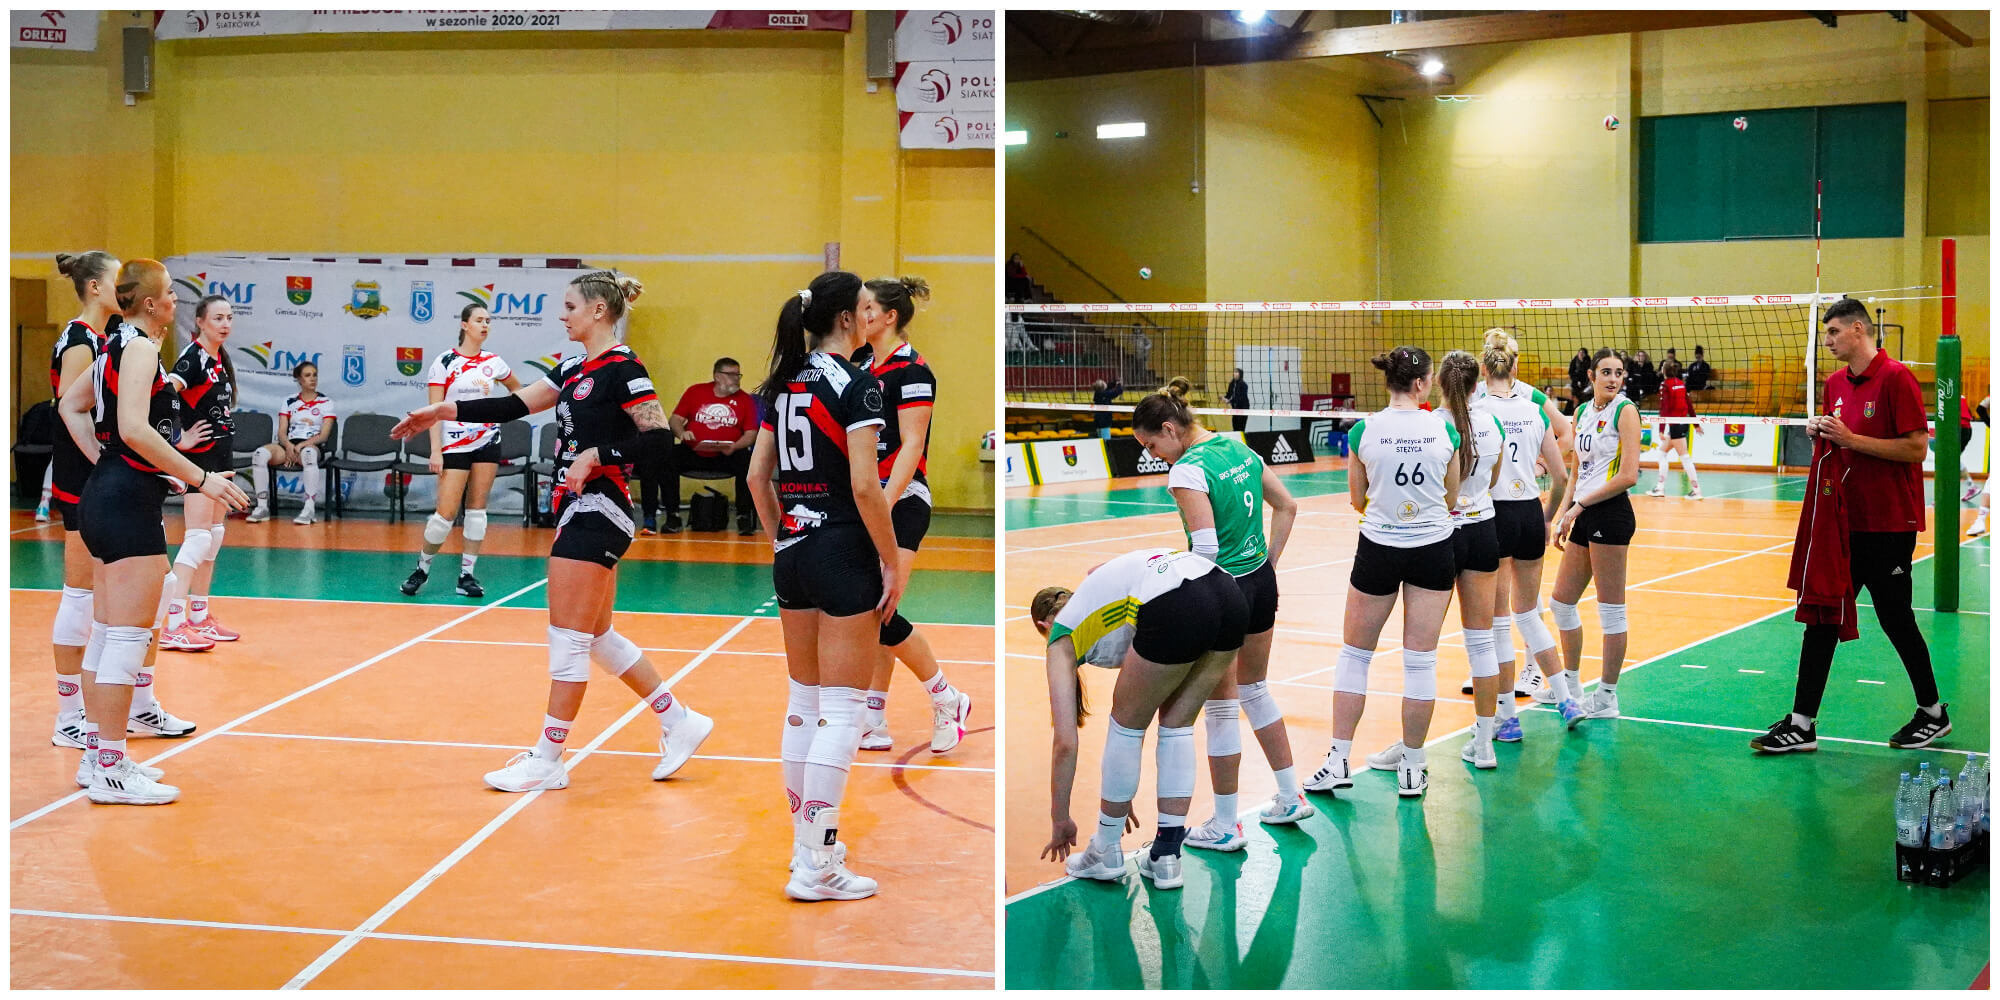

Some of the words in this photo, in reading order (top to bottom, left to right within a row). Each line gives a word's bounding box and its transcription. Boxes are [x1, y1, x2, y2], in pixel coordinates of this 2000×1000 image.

[215, 12, 261, 20] POLSKA
[426, 18, 436, 27] w
[439, 15, 487, 27] sezonie
[491, 14, 560, 27] 2020/2021
[770, 15, 806, 25] ORLEN
[22, 30, 64, 41] ORLEN
[209, 281, 256, 304] SMS
[491, 292, 548, 315] SMS
[271, 350, 323, 371] SMS
[774, 393, 814, 472] 15
[1579, 433, 1592, 452] 10
[1271, 452, 1299, 463] adidas
[1508, 442, 1518, 463] 2
[1137, 460, 1170, 474] adidas
[1394, 462, 1425, 487] 66
[1243, 490, 1254, 518] 9
